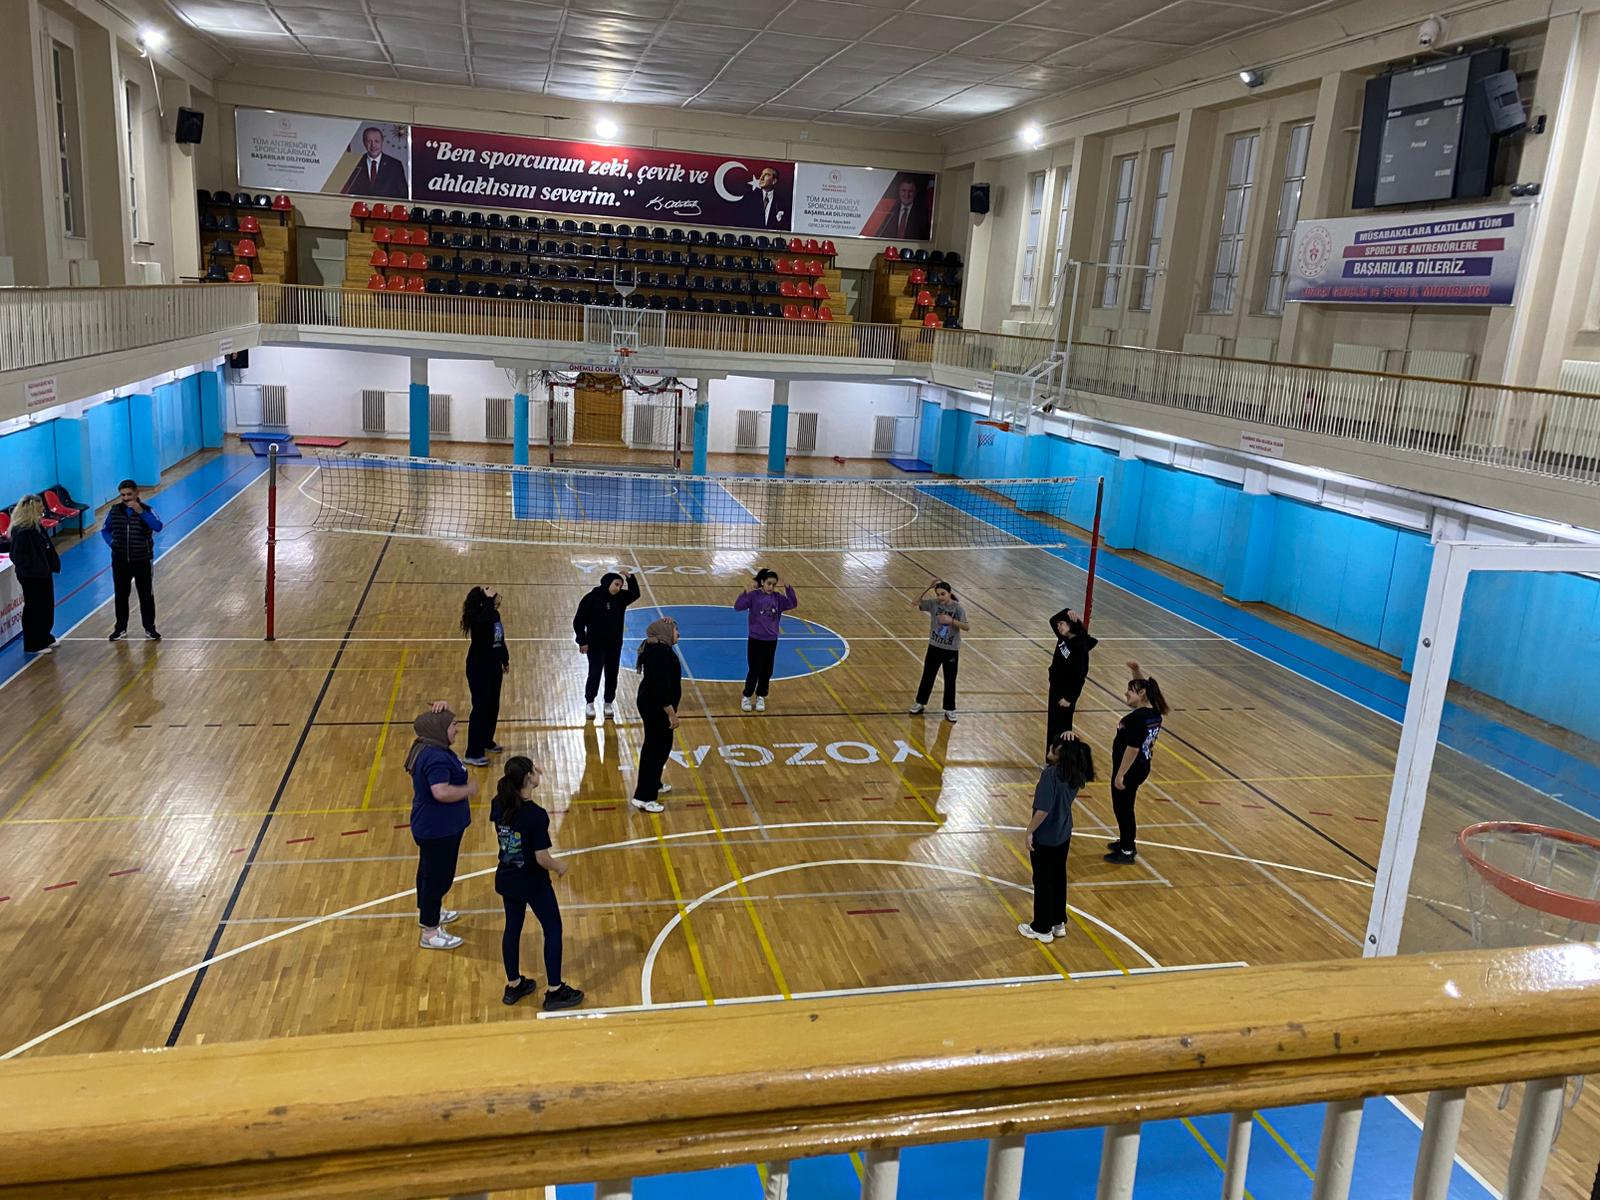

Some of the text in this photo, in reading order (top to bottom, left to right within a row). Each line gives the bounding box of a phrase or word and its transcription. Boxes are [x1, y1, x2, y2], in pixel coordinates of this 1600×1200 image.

[480, 150, 585, 173] sporcunun
[588, 158, 633, 180] zeki,
[637, 163, 685, 185] çevik
[689, 169, 709, 184] ve
[428, 174, 536, 199] ahlaklısını
[1360, 218, 1503, 241] MÜSABAKALARA KATILAN TÜM
[1365, 240, 1479, 255] SPORCU VE ANTRENÖRLERE
[1353, 258, 1465, 276] BAŞARILAR DİLERİZ.
